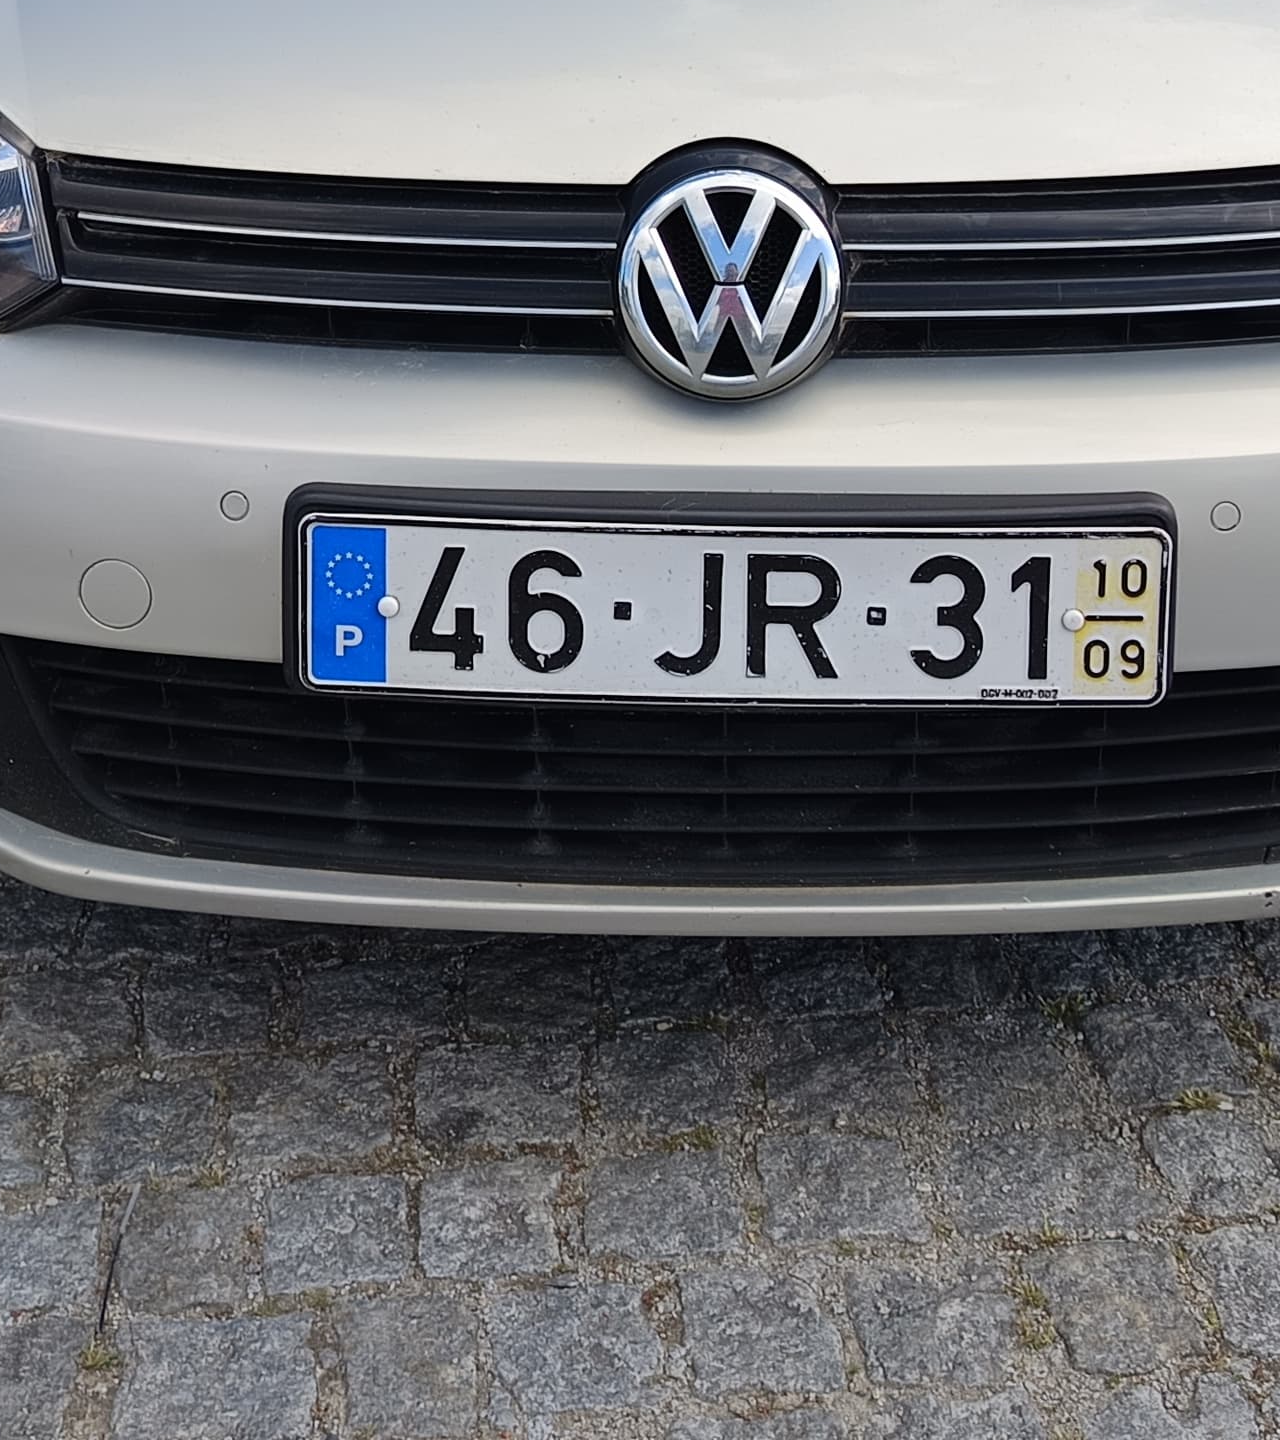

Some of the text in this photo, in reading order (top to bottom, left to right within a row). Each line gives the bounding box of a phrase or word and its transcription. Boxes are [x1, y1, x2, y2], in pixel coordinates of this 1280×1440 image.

[1093, 558, 1148, 598] 10
[335, 624, 364, 657] P
[1083, 639, 1145, 679] 09
